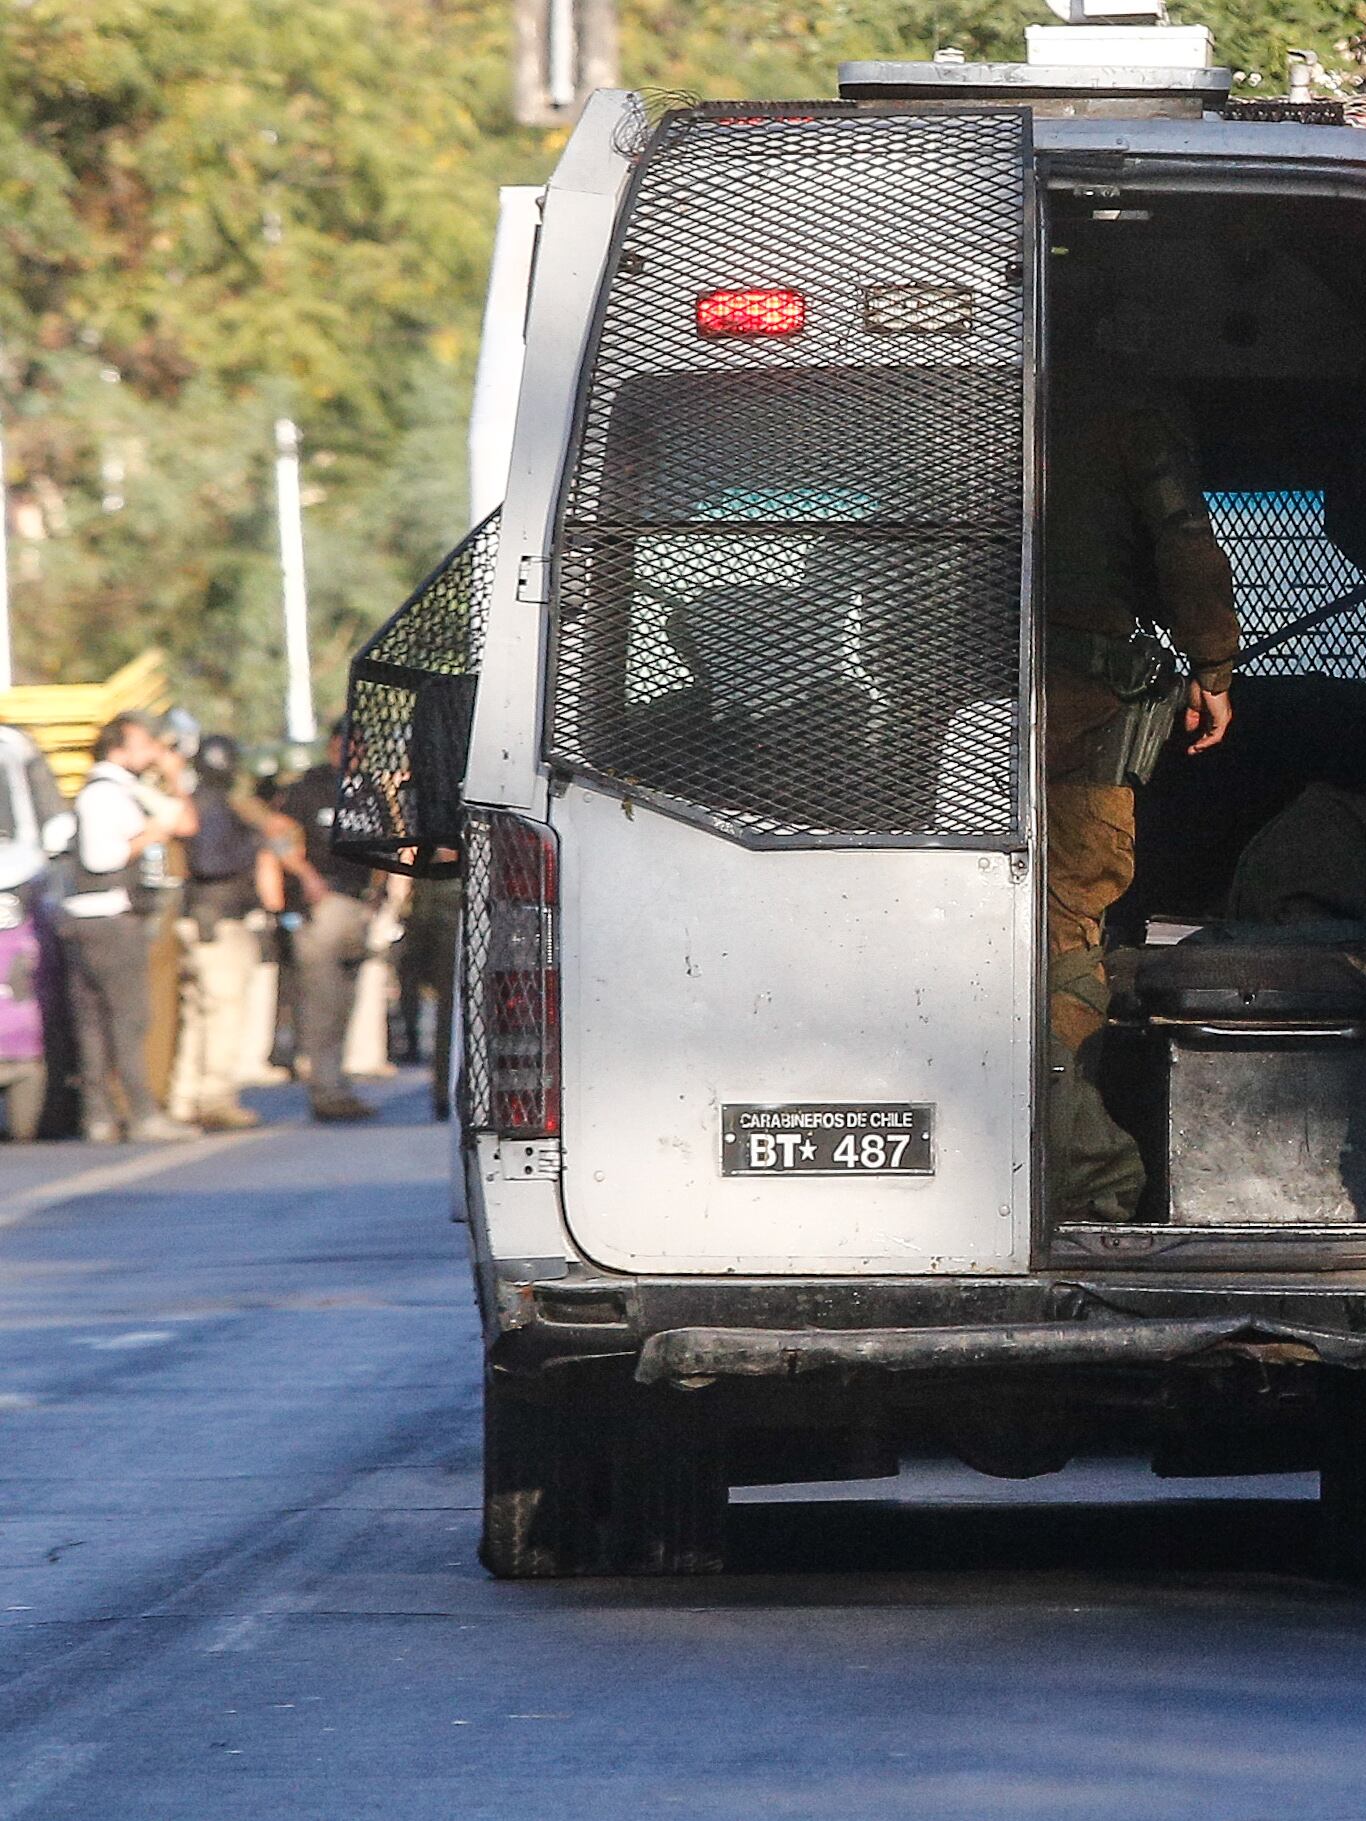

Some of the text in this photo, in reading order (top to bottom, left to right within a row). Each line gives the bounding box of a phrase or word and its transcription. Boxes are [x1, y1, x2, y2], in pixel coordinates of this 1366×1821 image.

[740, 1112, 913, 1128] CARABINEROS DE CHILE
[750, 1133, 911, 1168] BT 487
